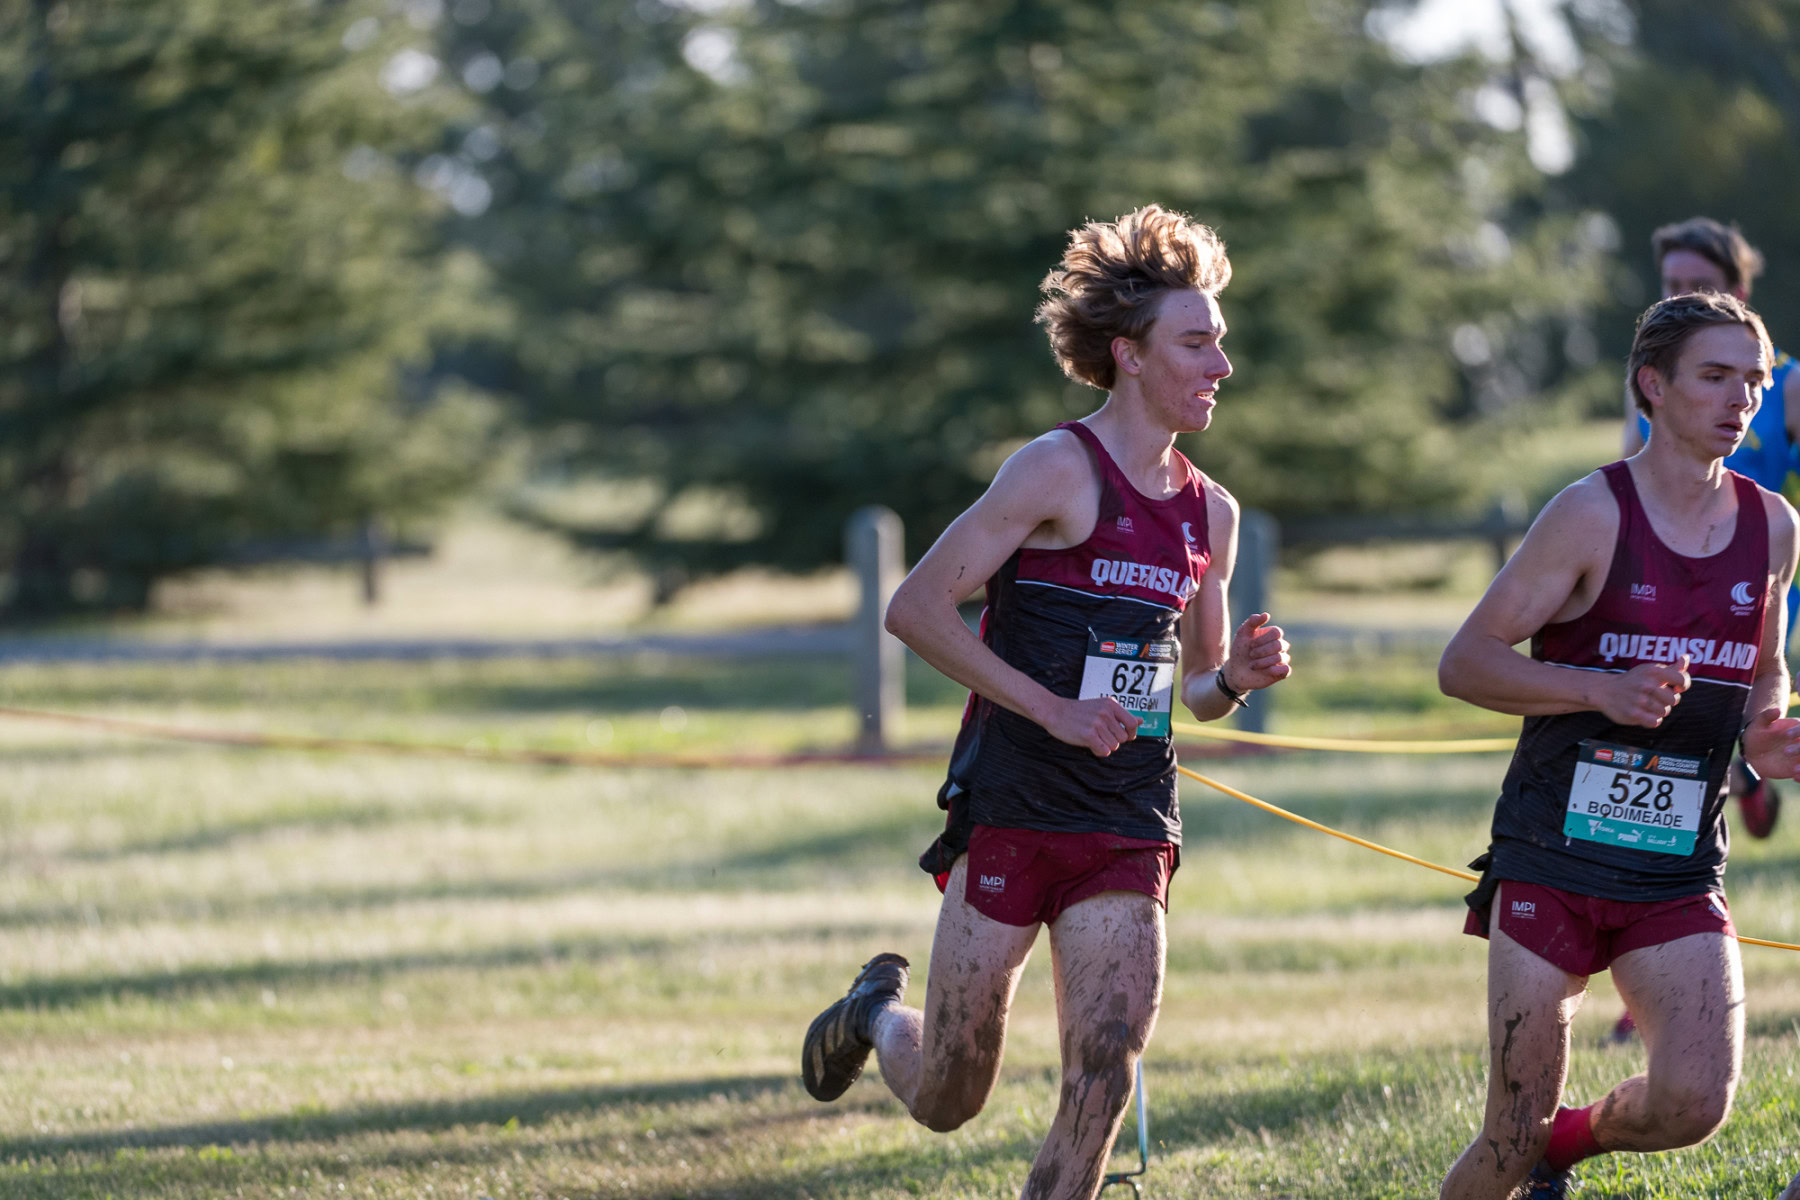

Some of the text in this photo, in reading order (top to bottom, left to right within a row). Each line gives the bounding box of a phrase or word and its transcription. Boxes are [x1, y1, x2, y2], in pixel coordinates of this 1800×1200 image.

[1090, 558, 1199, 601] QUEENSLA
[1115, 642, 1139, 650] WINTER
[1599, 632, 1758, 670] QUEENSLAND
[1111, 662, 1159, 696] 627
[1613, 750, 1643, 761] WINER
[1608, 772, 1674, 812] 528
[1587, 801, 1683, 828] BODIMEADE
[980, 874, 1005, 888] IMPI
[1511, 900, 1536, 913] IMPI
